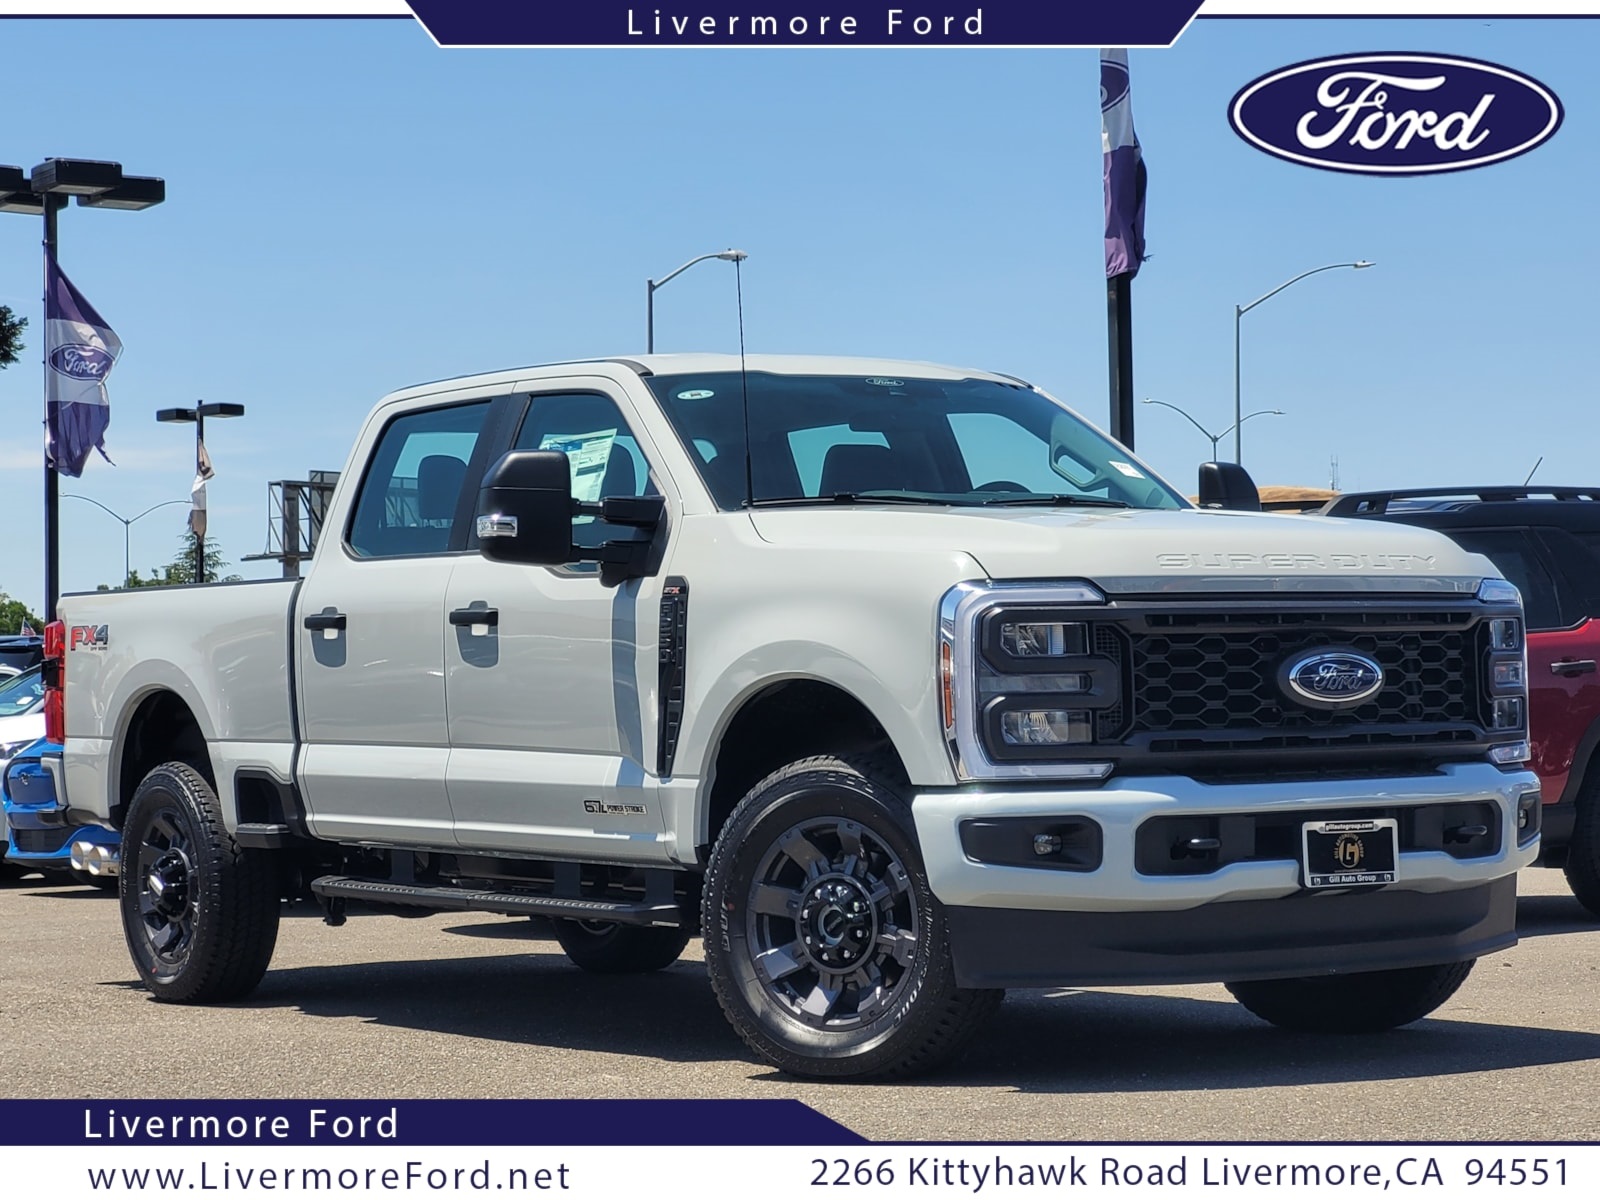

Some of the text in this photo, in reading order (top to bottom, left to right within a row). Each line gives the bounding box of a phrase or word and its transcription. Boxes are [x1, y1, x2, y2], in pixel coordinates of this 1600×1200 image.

[64, 348, 106, 374] Ford
[1156, 553, 1437, 570] SUPER DUTY
[70, 624, 109, 651] FX4
[1313, 663, 1363, 691] Ford
[1325, 823, 1374, 831] gillautogroup.com
[1329, 874, 1377, 883] Gill Auto Group
